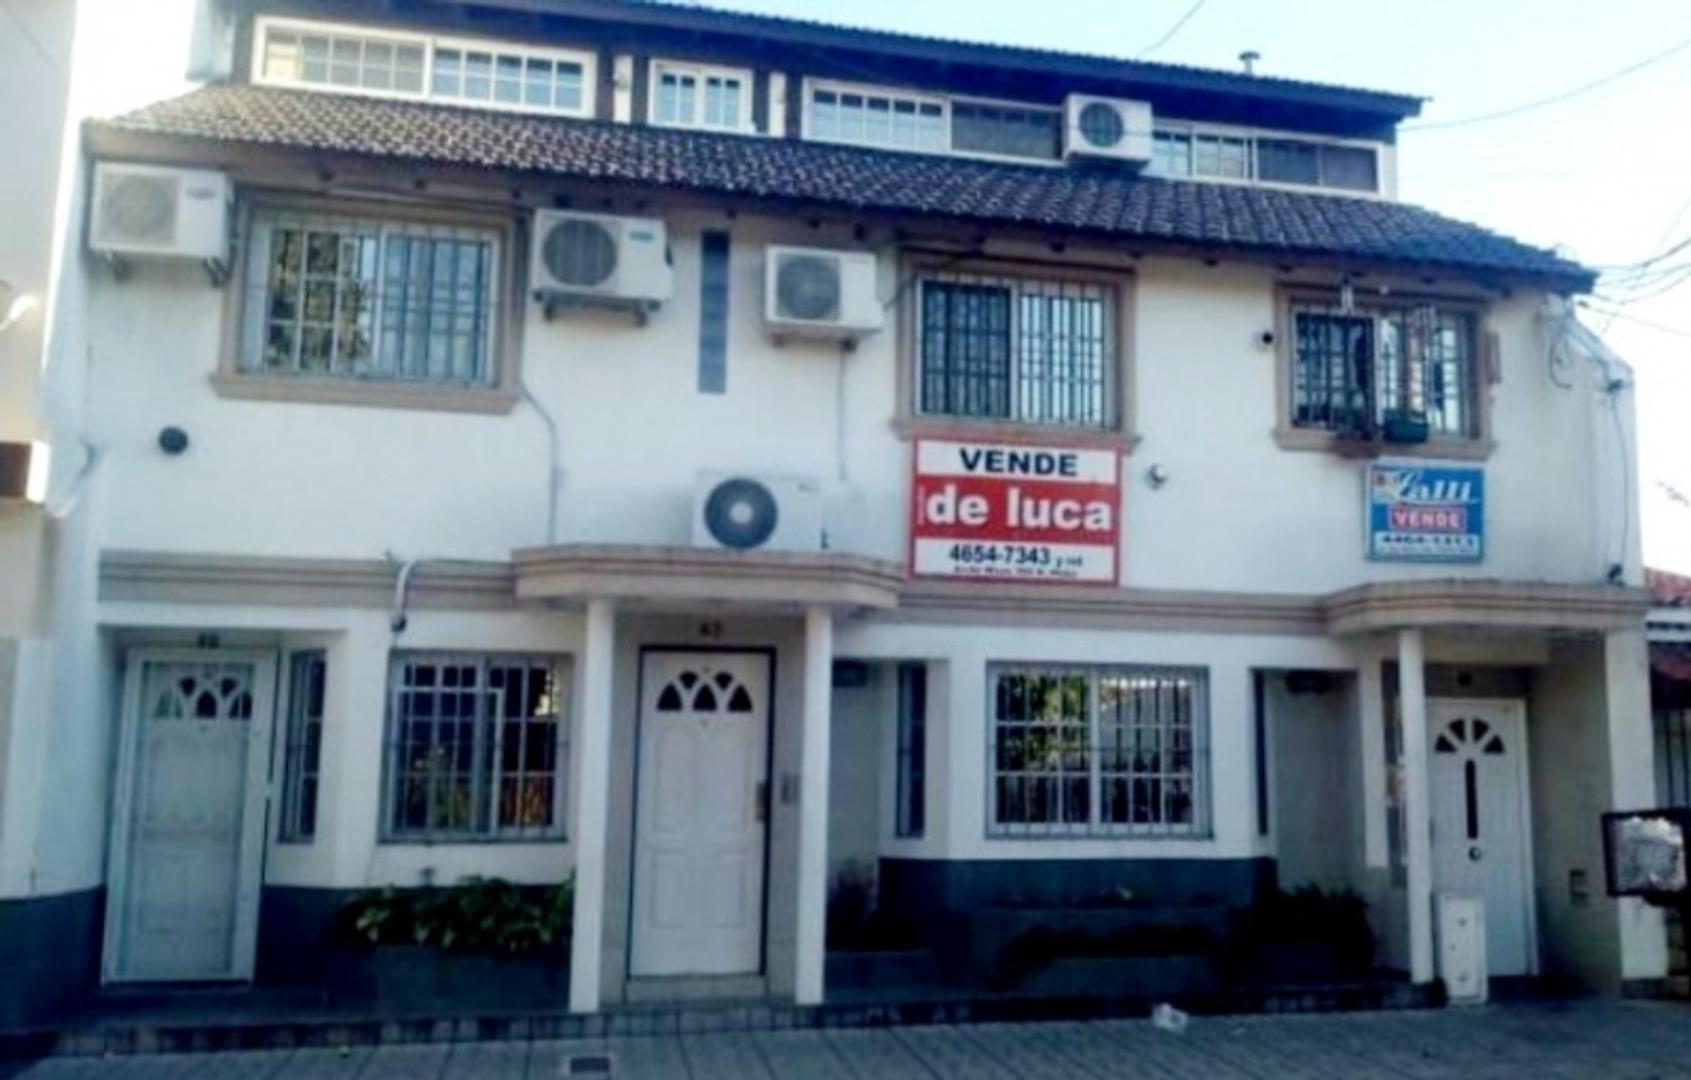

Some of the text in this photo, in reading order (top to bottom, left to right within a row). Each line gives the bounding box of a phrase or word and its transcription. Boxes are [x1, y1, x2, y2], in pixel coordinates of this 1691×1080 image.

[959, 447, 1078, 477] VENDE
[926, 483, 989, 526] de
[1006, 486, 1111, 531] luca
[1393, 508, 1461, 529] VENDE
[948, 543, 1051, 566] 4654-7343
